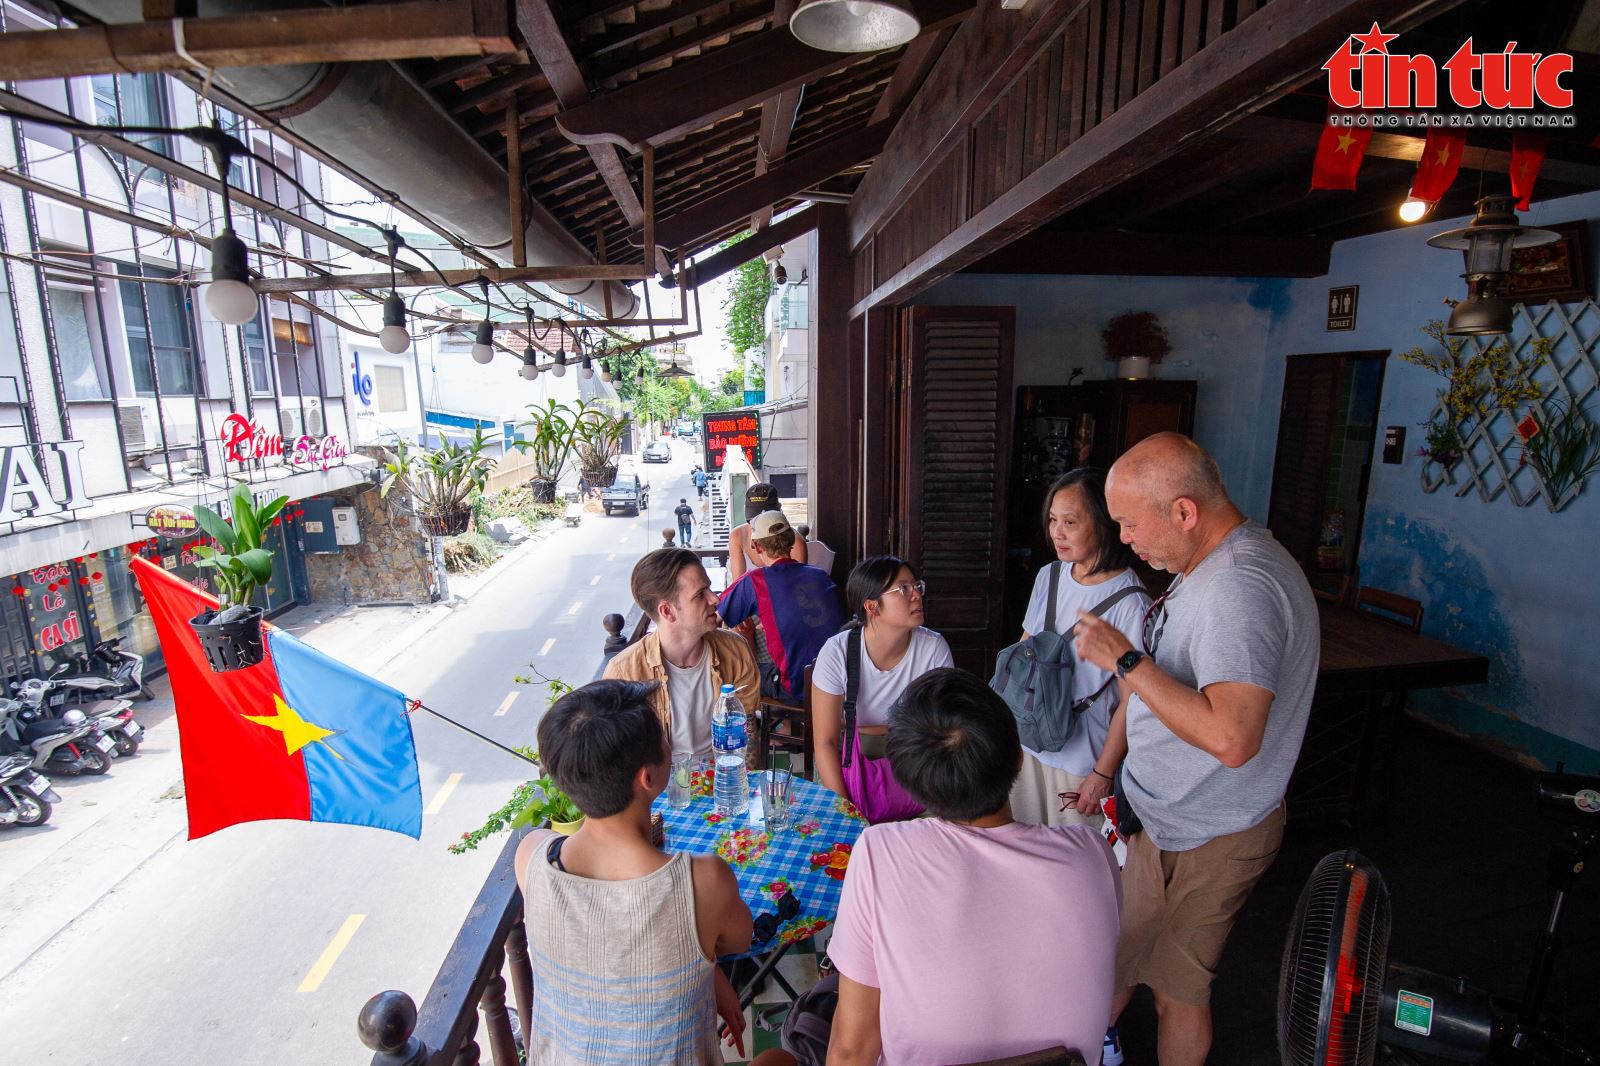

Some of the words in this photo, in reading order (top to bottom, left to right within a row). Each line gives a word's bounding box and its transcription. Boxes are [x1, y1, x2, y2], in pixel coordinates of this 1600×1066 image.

[1330, 320, 1350, 328] TOILET
[737, 417, 756, 430] TÂM
[41, 624, 65, 651] CA
